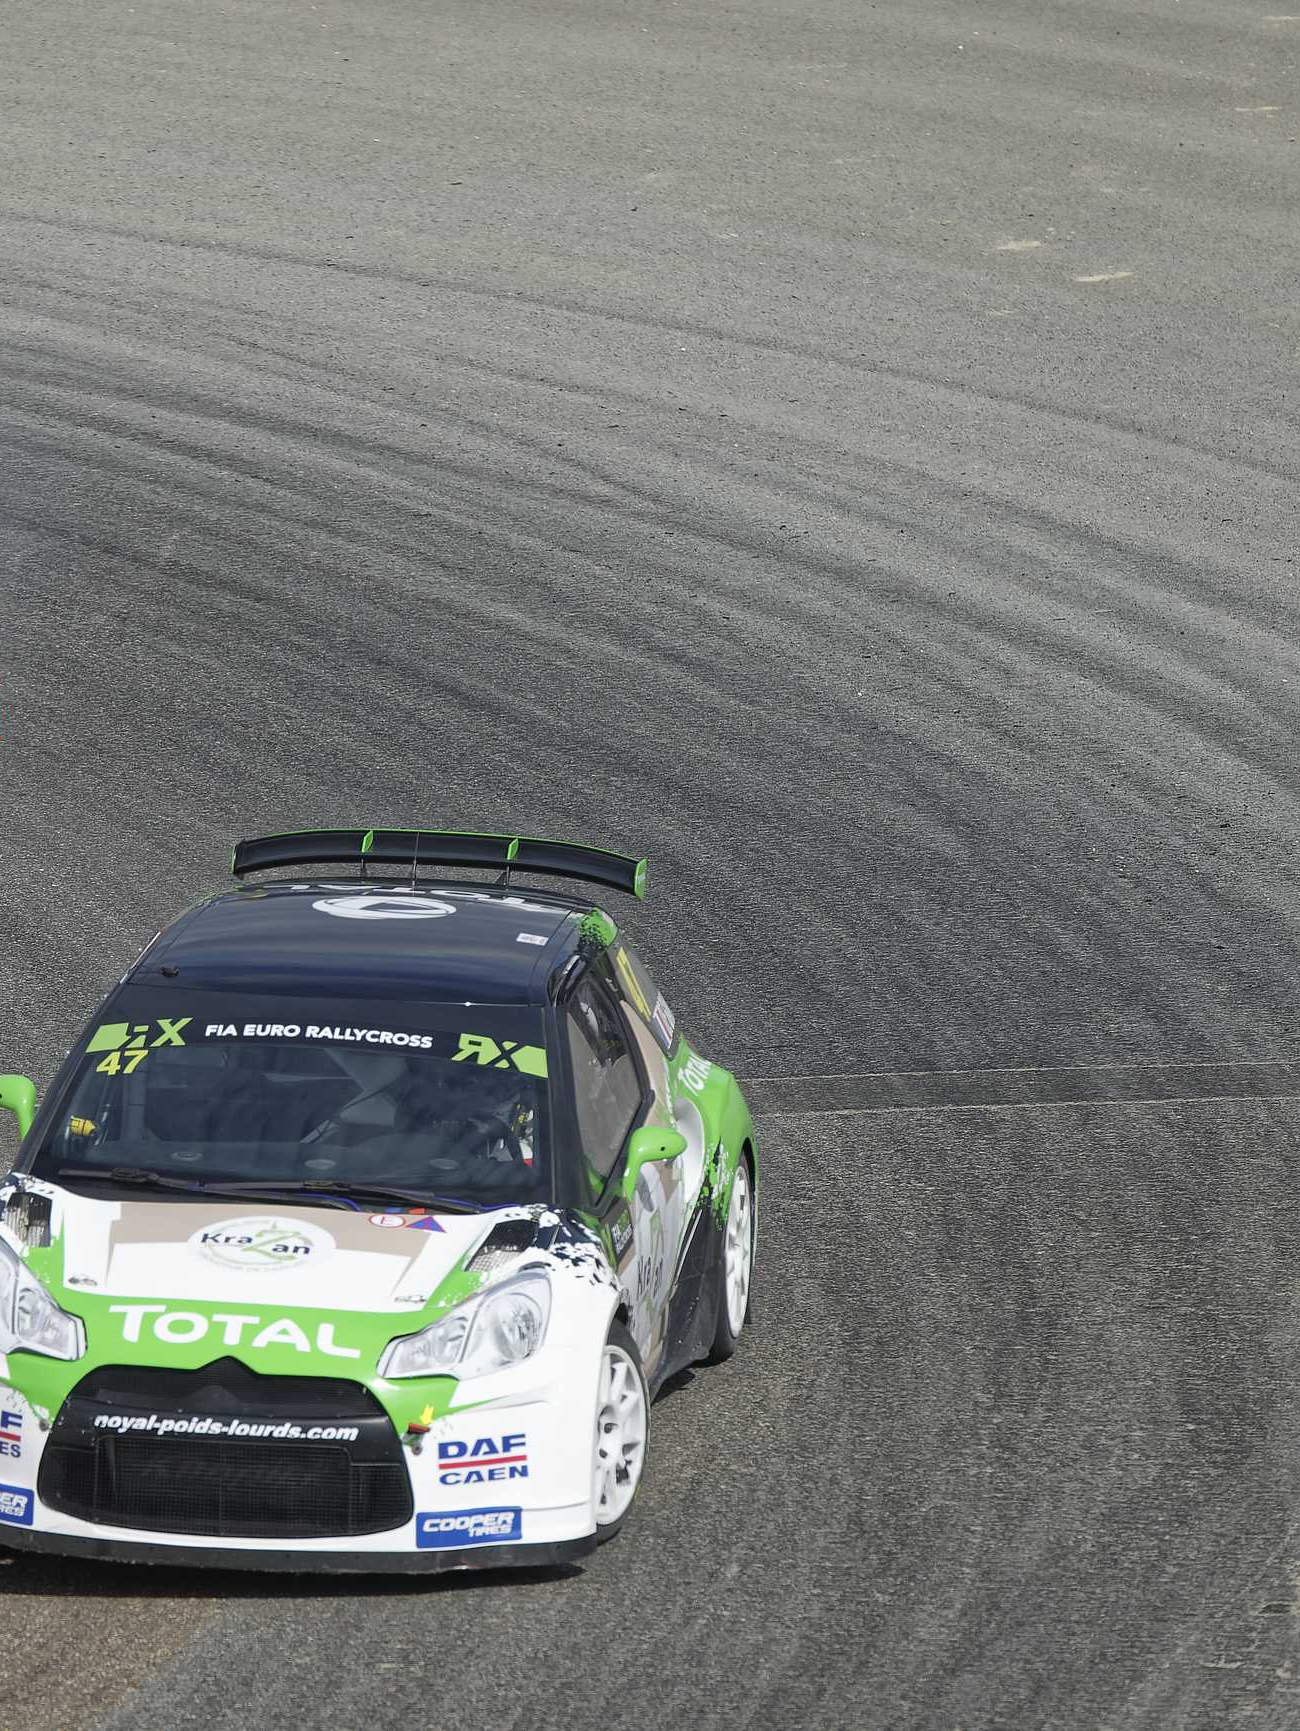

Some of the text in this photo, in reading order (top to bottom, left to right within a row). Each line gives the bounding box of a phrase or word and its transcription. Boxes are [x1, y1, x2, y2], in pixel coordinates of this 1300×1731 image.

[205, 1024, 237, 1038] FIA
[243, 1024, 301, 1039] EURO
[305, 1024, 433, 1050] RALLYCROSS
[96, 1050, 149, 1076] 47
[109, 1305, 361, 1359] TOTAL
[94, 1414, 359, 1442] noyal-poids-lourds.com
[438, 1434, 526, 1461] DAF
[438, 1465, 529, 1486] CAEN
[422, 1511, 515, 1533] COOPER
[468, 1525, 512, 1537] TIRES
